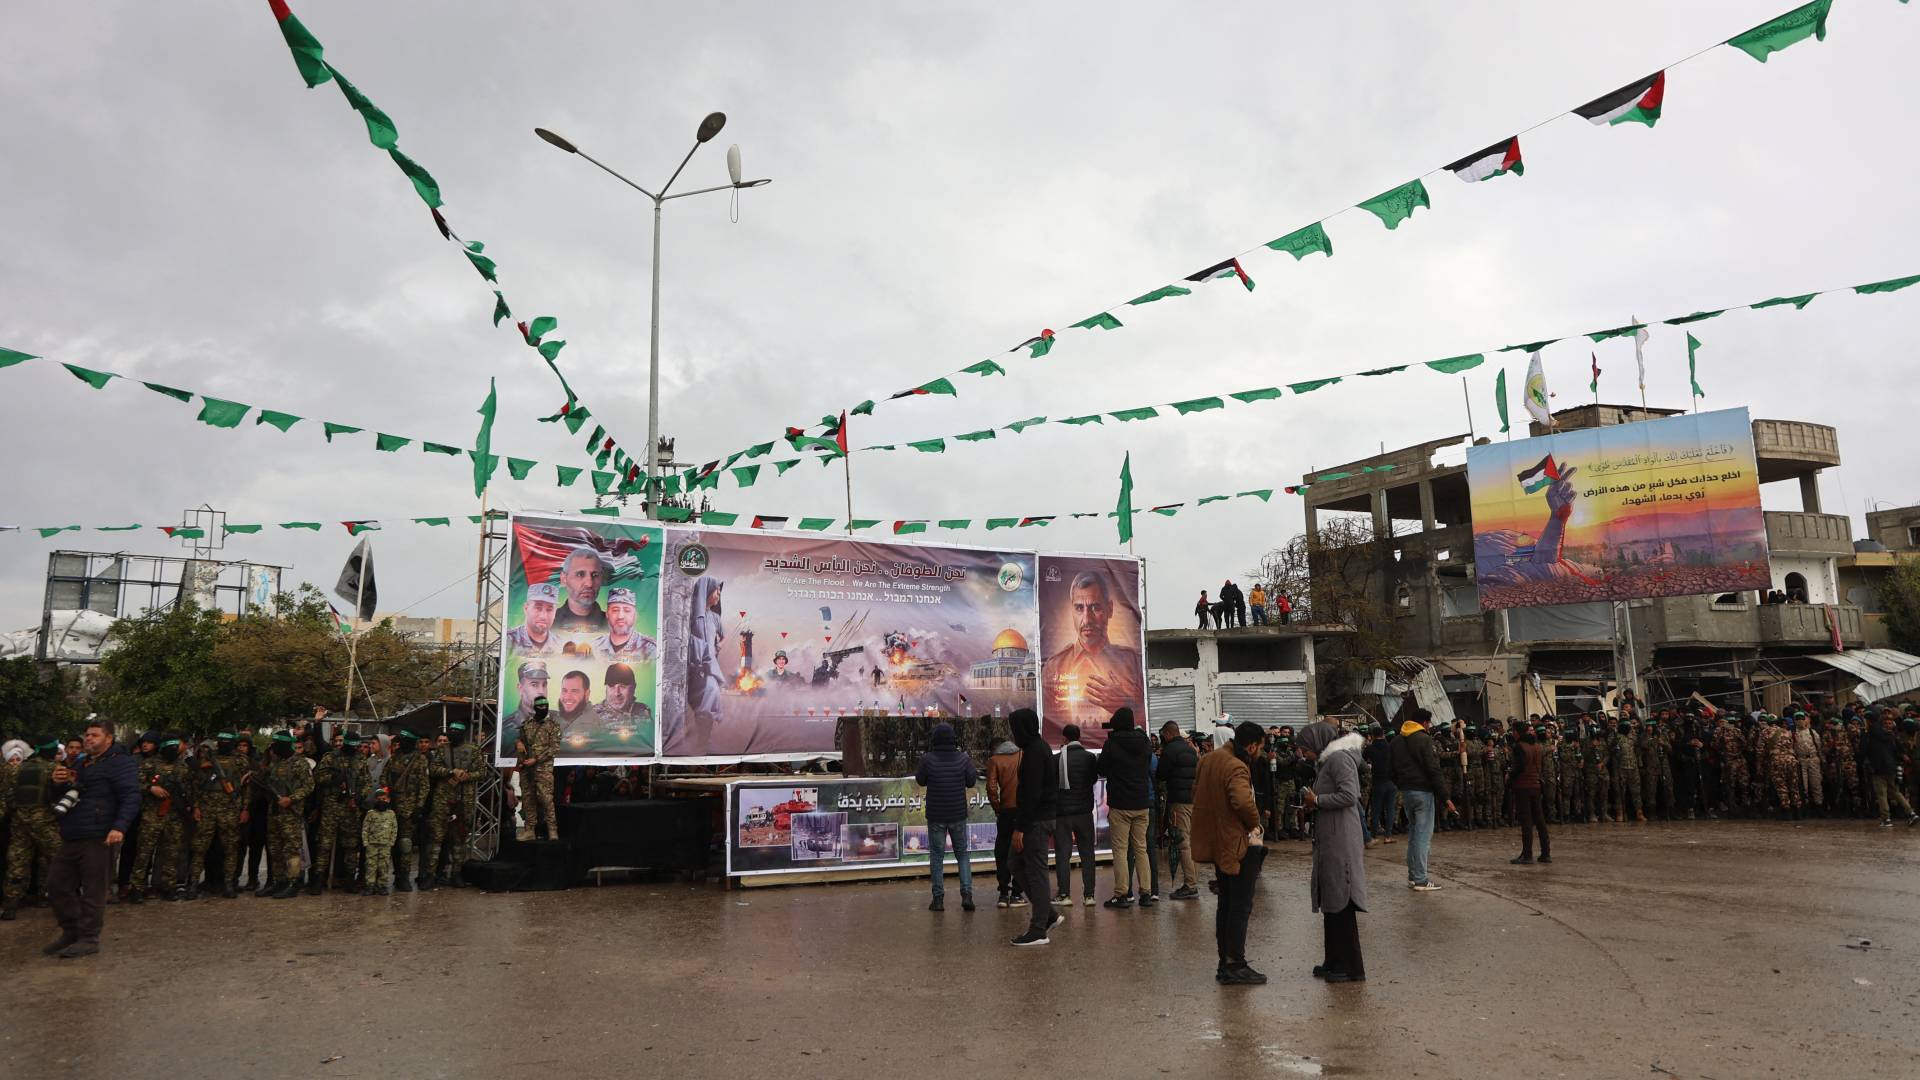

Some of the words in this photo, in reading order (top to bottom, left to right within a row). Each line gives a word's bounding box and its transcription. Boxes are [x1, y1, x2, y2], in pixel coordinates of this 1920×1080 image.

[1667, 477, 1687, 488] فكل
[1721, 471, 1740, 482] اخلع
[1610, 484, 1630, 493] هذه
[1632, 483, 1646, 492] من
[1622, 493, 1656, 506] الشهداء
[764, 553, 810, 572] الشديد
[813, 554, 850, 575] البأس
[853, 560, 877, 576] نحن
[891, 562, 942, 580] الطوفان
[943, 566, 967, 581] نحن
[780, 577, 792, 585] We
[794, 577, 806, 585] Are
[808, 577, 821, 586] The
[823, 578, 845, 587] Flood
[853, 580, 863, 588] We
[864, 580, 877, 589] Are
[878, 581, 891, 589] The
[893, 582, 920, 591] Extreme
[921, 584, 951, 593] Strength
[848, 592, 874, 601] אנחנו
[884, 591, 913, 603] המבול
[915, 594, 941, 604] אנחנו
